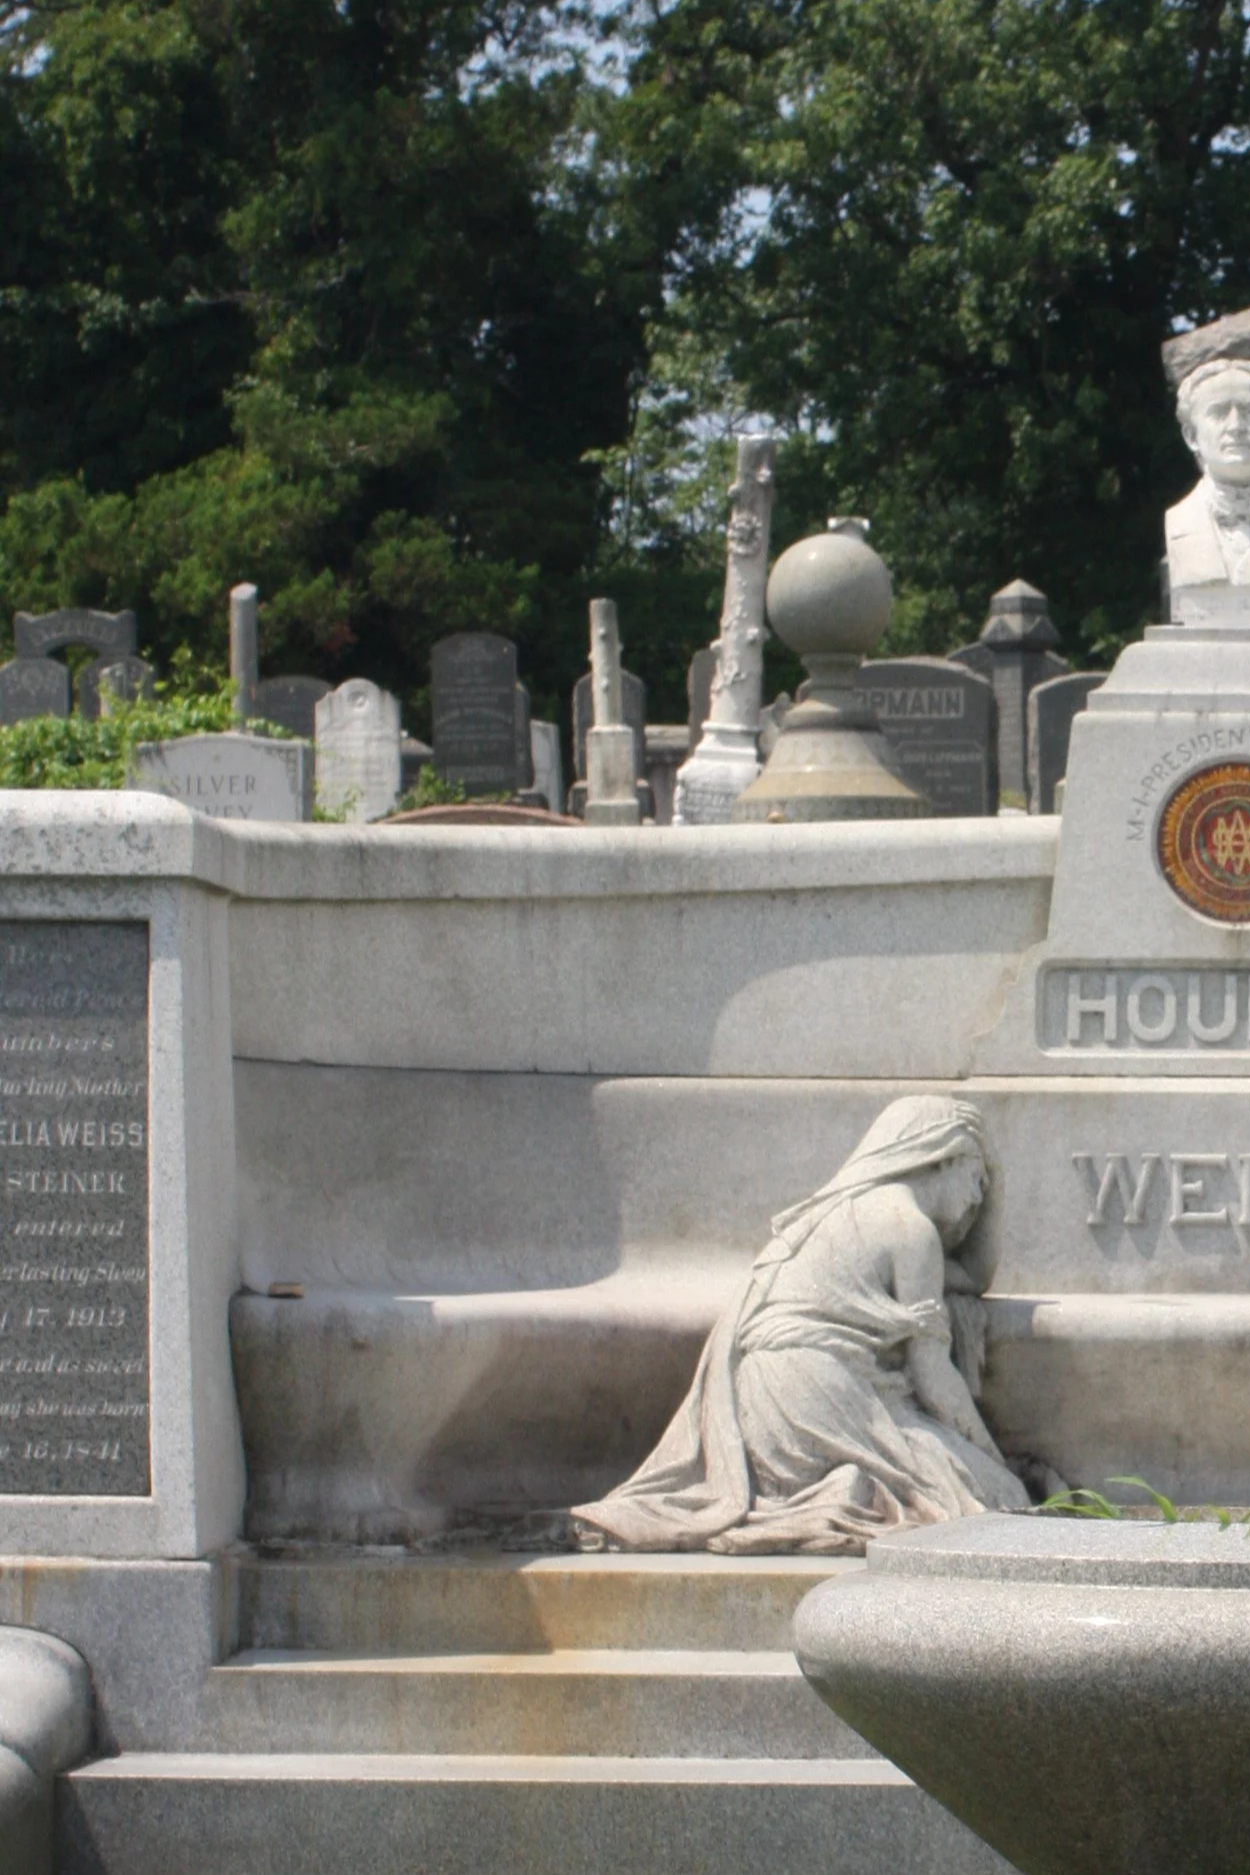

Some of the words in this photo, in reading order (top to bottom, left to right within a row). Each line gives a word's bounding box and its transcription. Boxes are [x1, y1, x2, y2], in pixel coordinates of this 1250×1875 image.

[170, 774, 257, 796] SILVER
[0, 1077, 68, 1101] arling
[57, 1120, 144, 1147] WEISS
[7, 1169, 126, 1193] STEINER
[13, 1219, 126, 1237] entered
[66, 1306, 127, 1328] 1913
